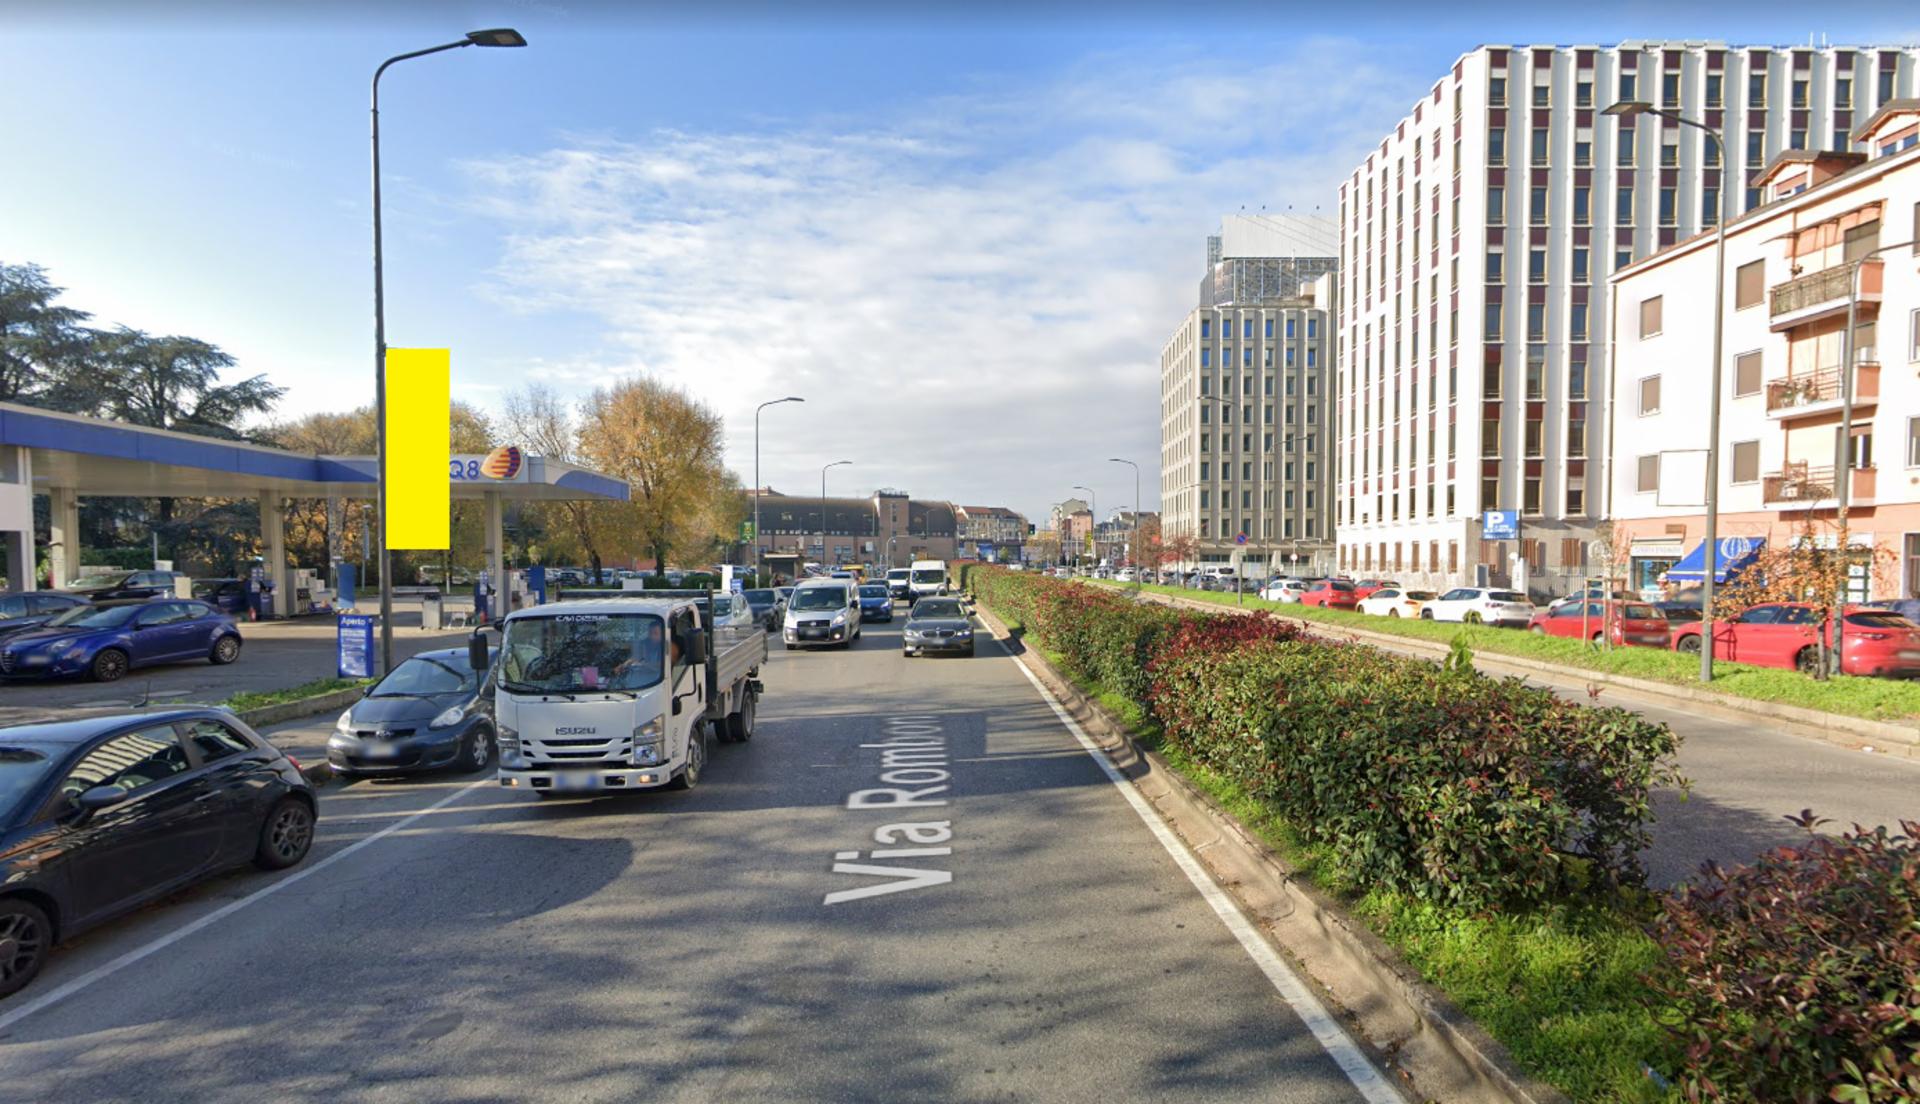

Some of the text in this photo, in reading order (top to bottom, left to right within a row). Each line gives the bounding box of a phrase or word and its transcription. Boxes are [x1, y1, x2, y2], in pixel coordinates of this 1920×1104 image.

[450, 460, 480, 480] Q8
[1487, 511, 1504, 528] P
[555, 727, 596, 735] ISUZU
